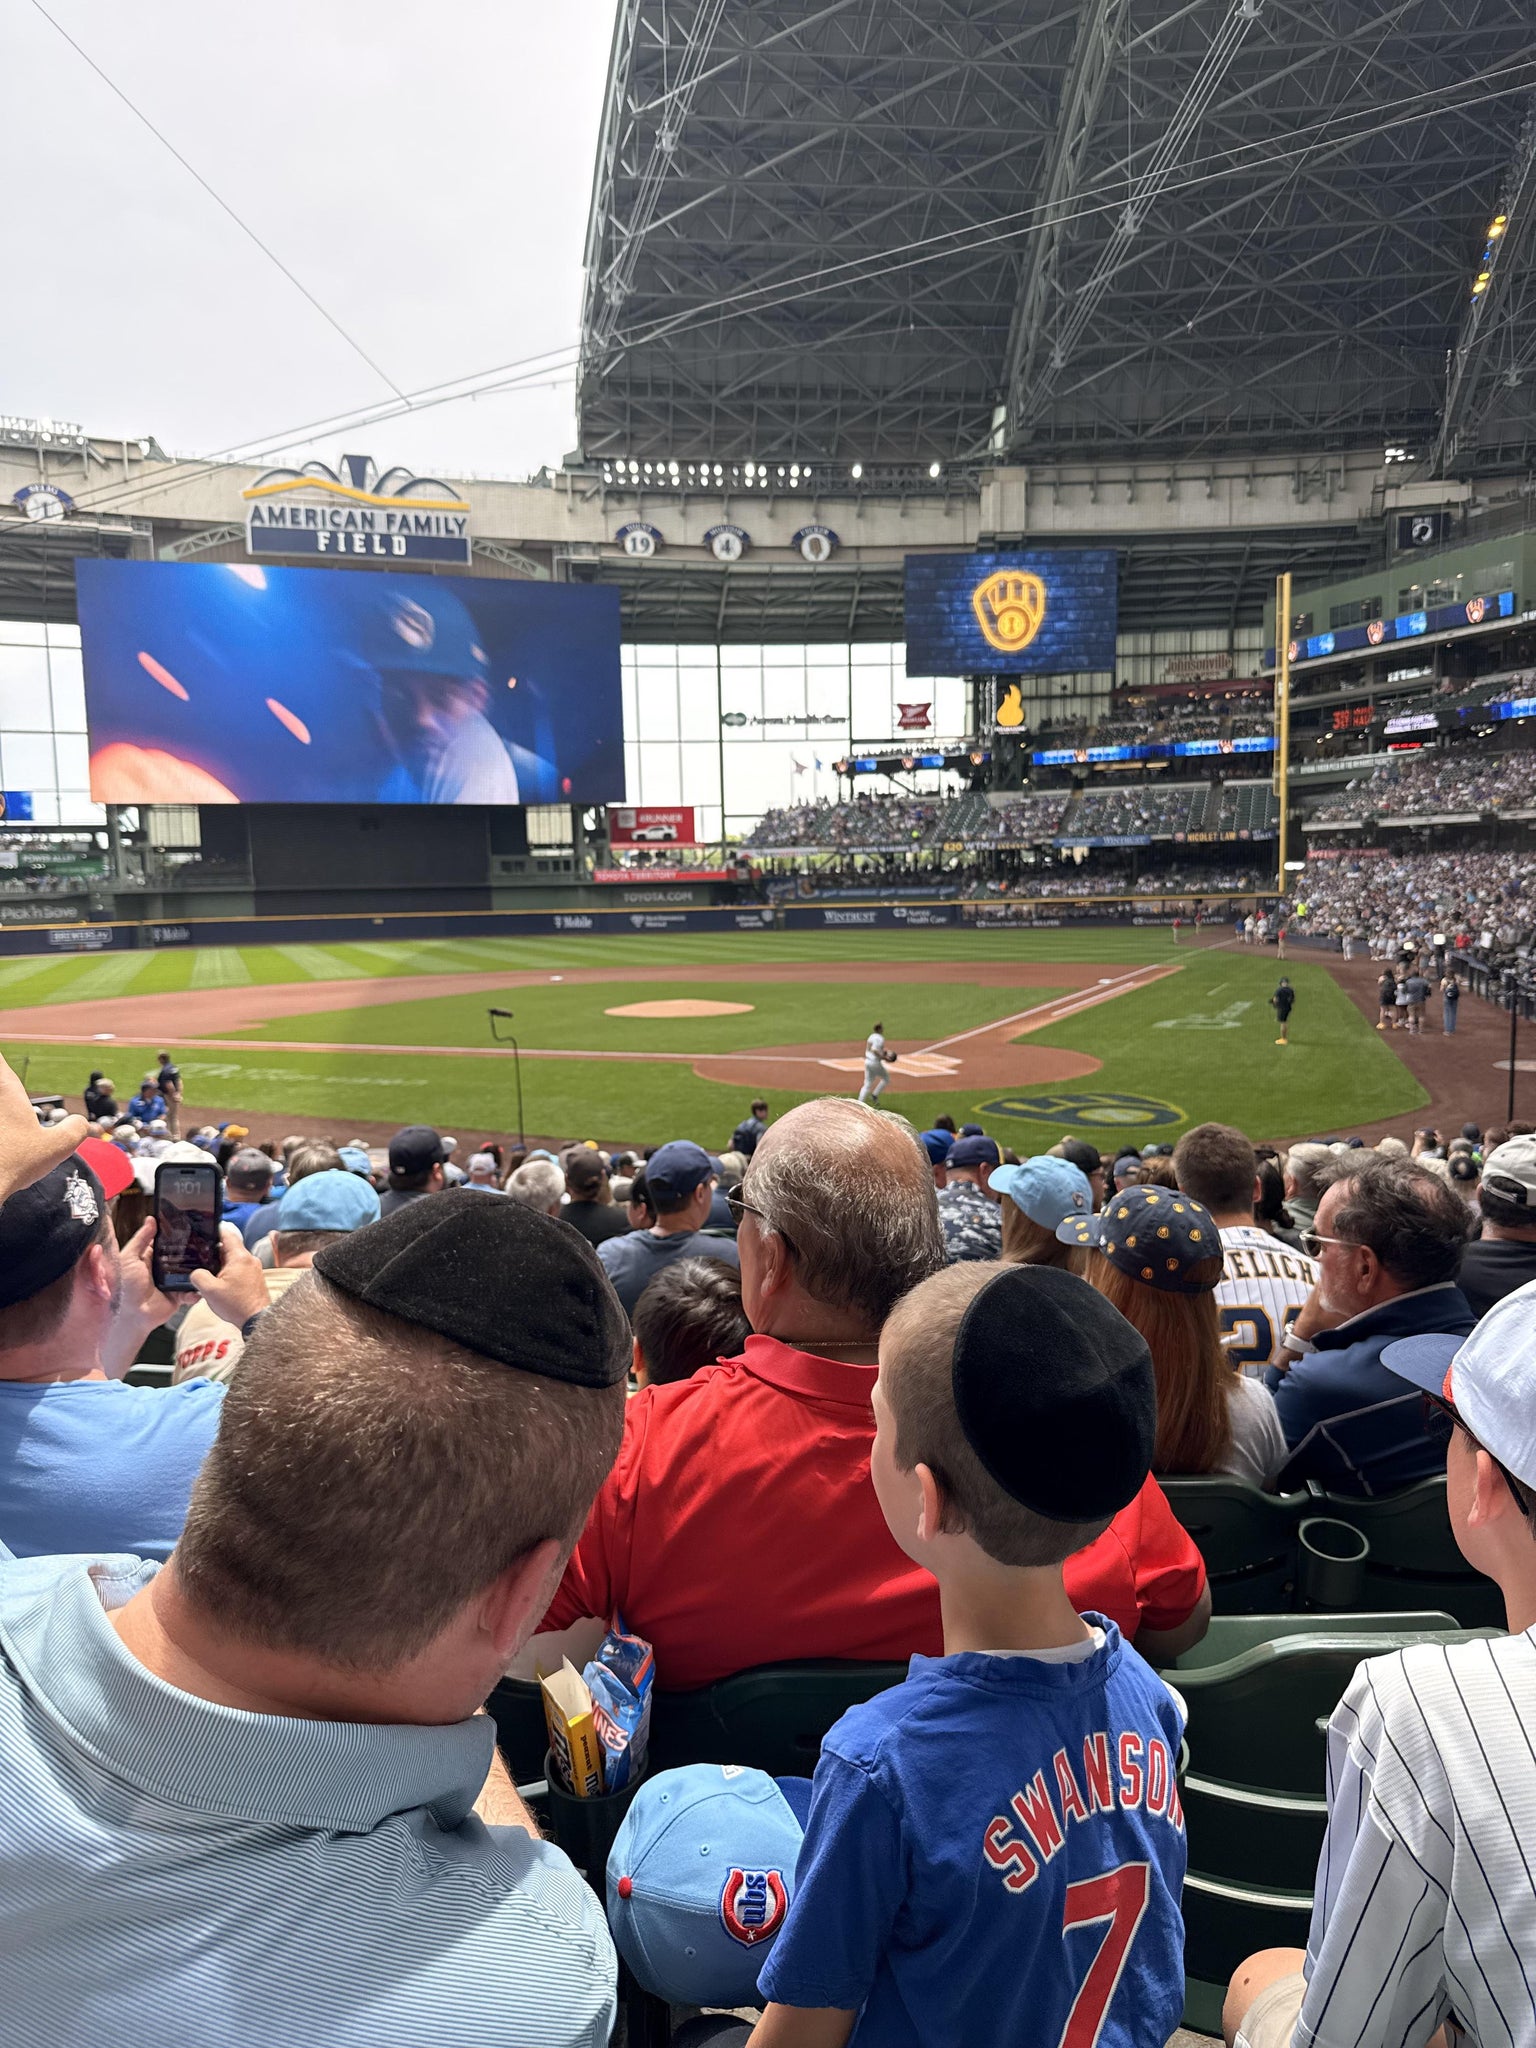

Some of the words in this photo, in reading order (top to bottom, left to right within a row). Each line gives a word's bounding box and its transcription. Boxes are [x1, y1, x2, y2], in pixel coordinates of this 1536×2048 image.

[251, 505, 375, 531] AMERICAN
[386, 512, 467, 536] FAMILY
[316, 530, 407, 556] FIELD
[631, 537, 650, 553] 19
[1166, 653, 1232, 674] Johnsonville
[1187, 832, 1218, 843] NICOLET
[1220, 831, 1236, 841] LAW
[580, 1735, 593, 1771] peanut
[1056, 1860, 1151, 2048] 7
